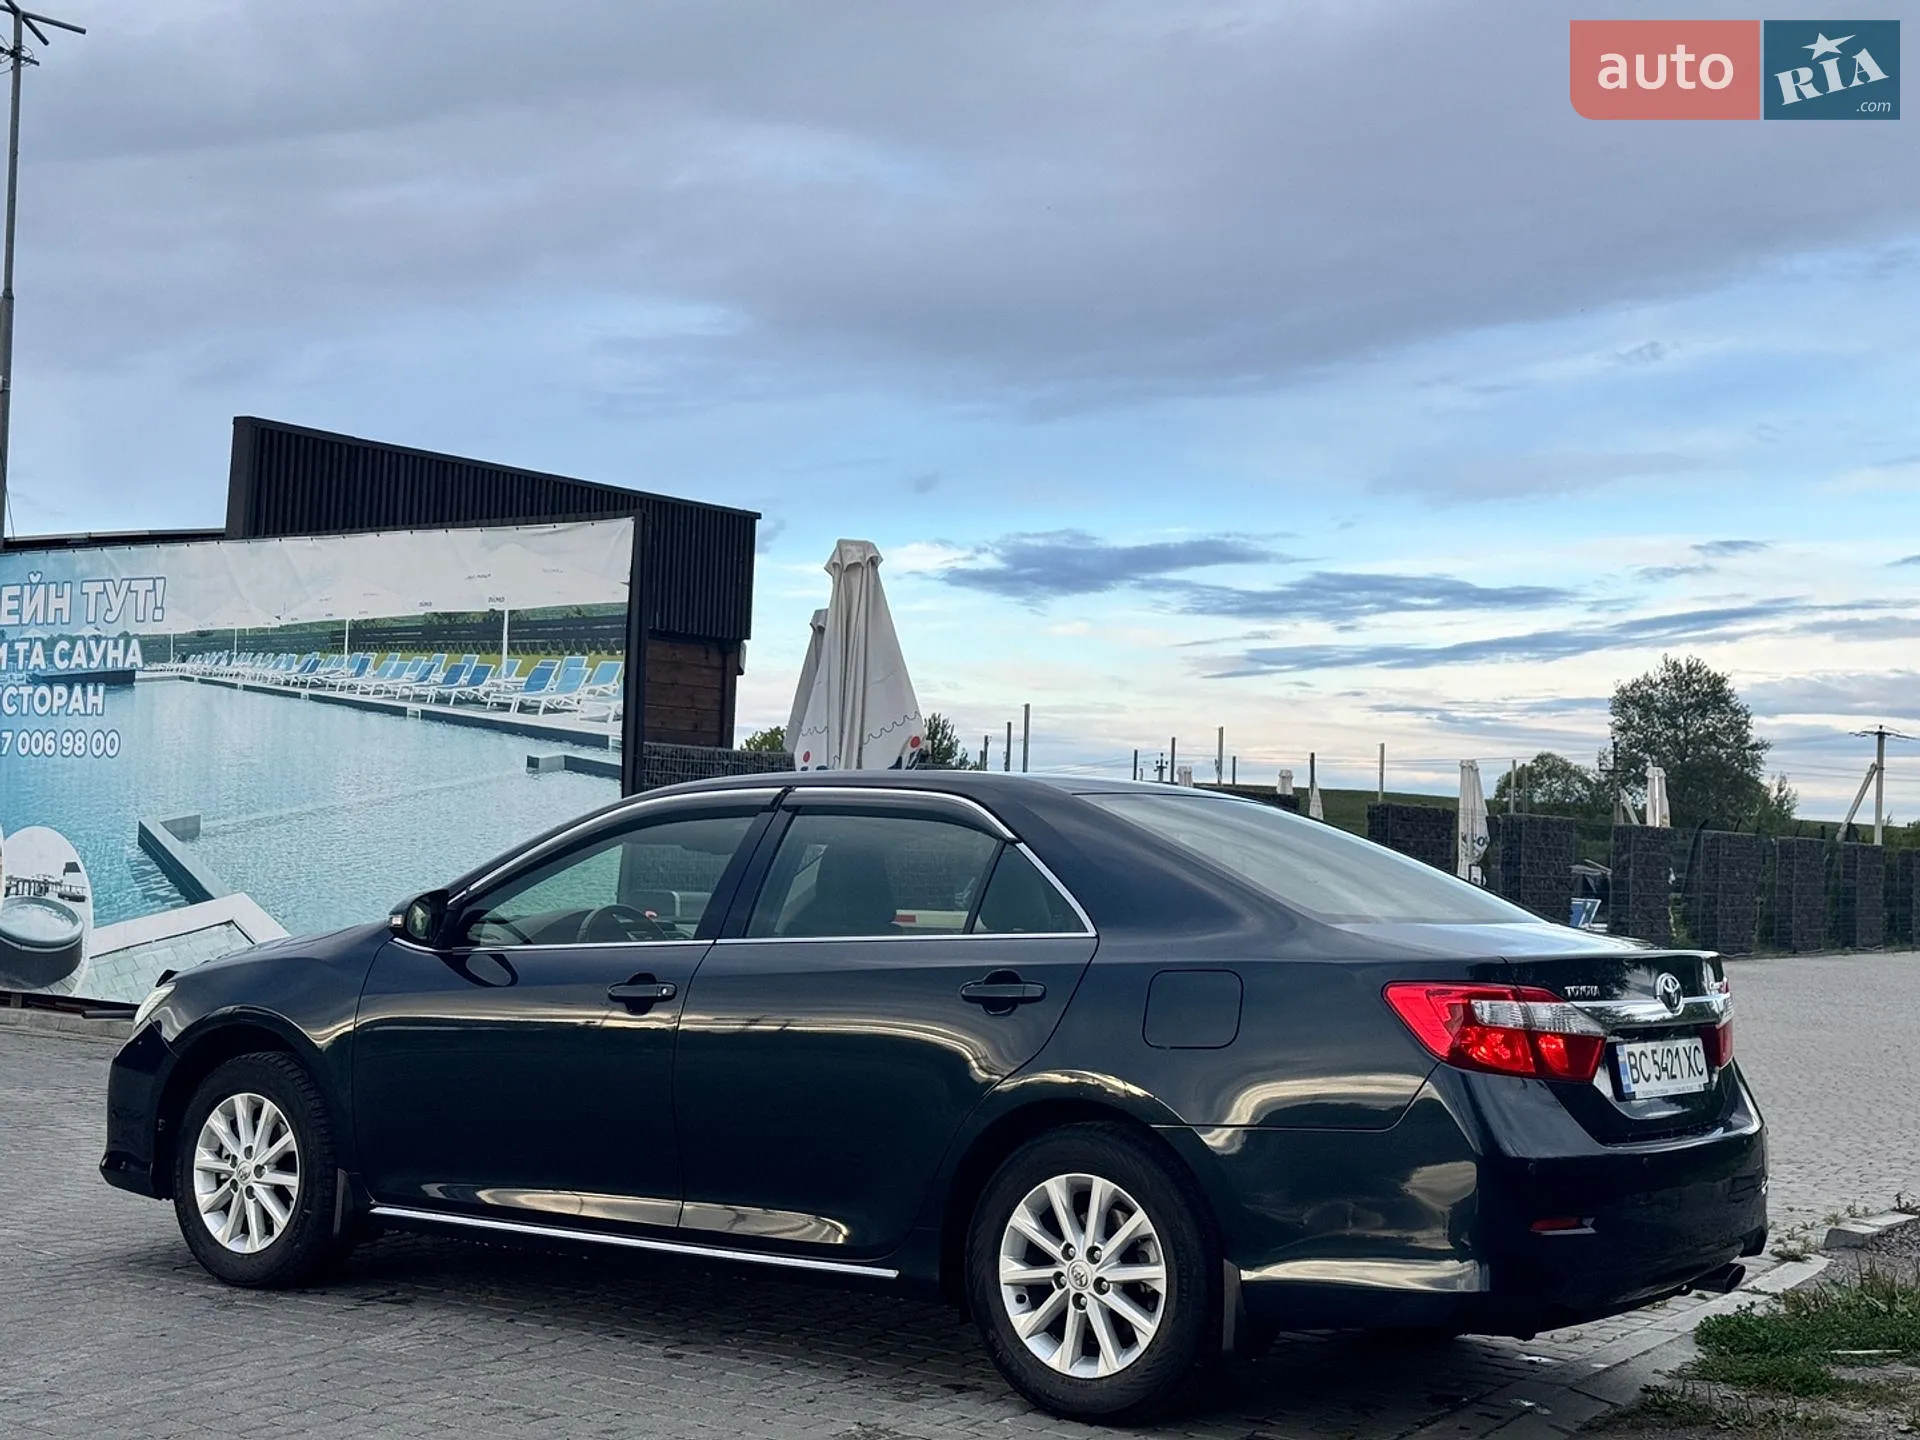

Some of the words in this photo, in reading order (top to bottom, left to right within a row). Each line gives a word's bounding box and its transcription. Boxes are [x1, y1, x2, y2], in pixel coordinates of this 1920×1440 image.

[81, 577, 166, 623] ТУТ!
[14, 639, 47, 670] ТА
[53, 637, 145, 671] САУНА
[0, 683, 105, 716] СТОРАН
[17, 729, 57, 757] 006
[60, 729, 87, 758] 98
[91, 729, 120, 758] 00
[1627, 1049, 1651, 1083] BC
[1651, 1046, 1684, 1080] 5421
[1683, 1044, 1704, 1077] XC
